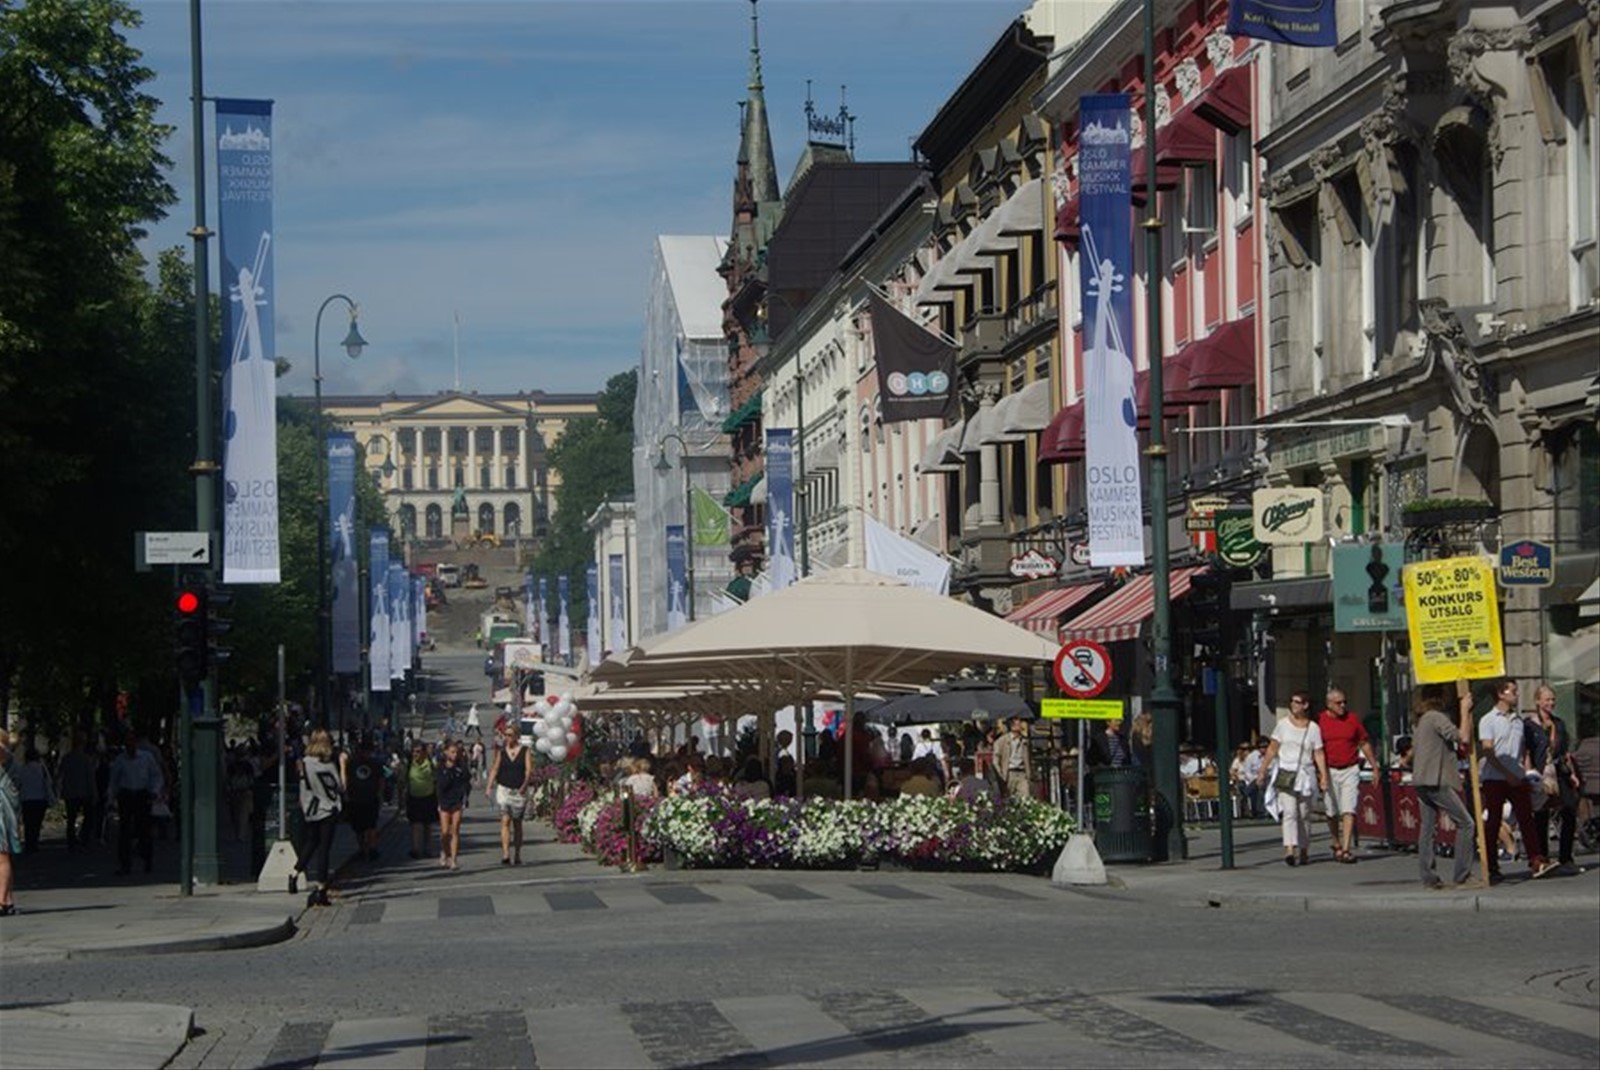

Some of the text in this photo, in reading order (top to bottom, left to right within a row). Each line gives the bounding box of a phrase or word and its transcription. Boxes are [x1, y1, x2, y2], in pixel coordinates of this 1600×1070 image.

[1081, 149, 1107, 160] OSLO
[1081, 160, 1127, 171] KAMMER
[1081, 172, 1121, 182] MUSIKK
[1081, 183, 1127, 195] FESTIVAL
[1089, 465, 1137, 485] OSLO
[1089, 485, 1139, 503] KAMMER
[1090, 505, 1139, 522] MUSIKK
[1090, 523, 1140, 541] FESTIVAL
[1512, 555, 1539, 568] Best
[1416, 569, 1444, 587] 50%
[1454, 566, 1481, 582] 80%
[1501, 566, 1550, 579] Western
[1418, 590, 1484, 608] KONKURS
[1429, 604, 1473, 619] UTSALG
